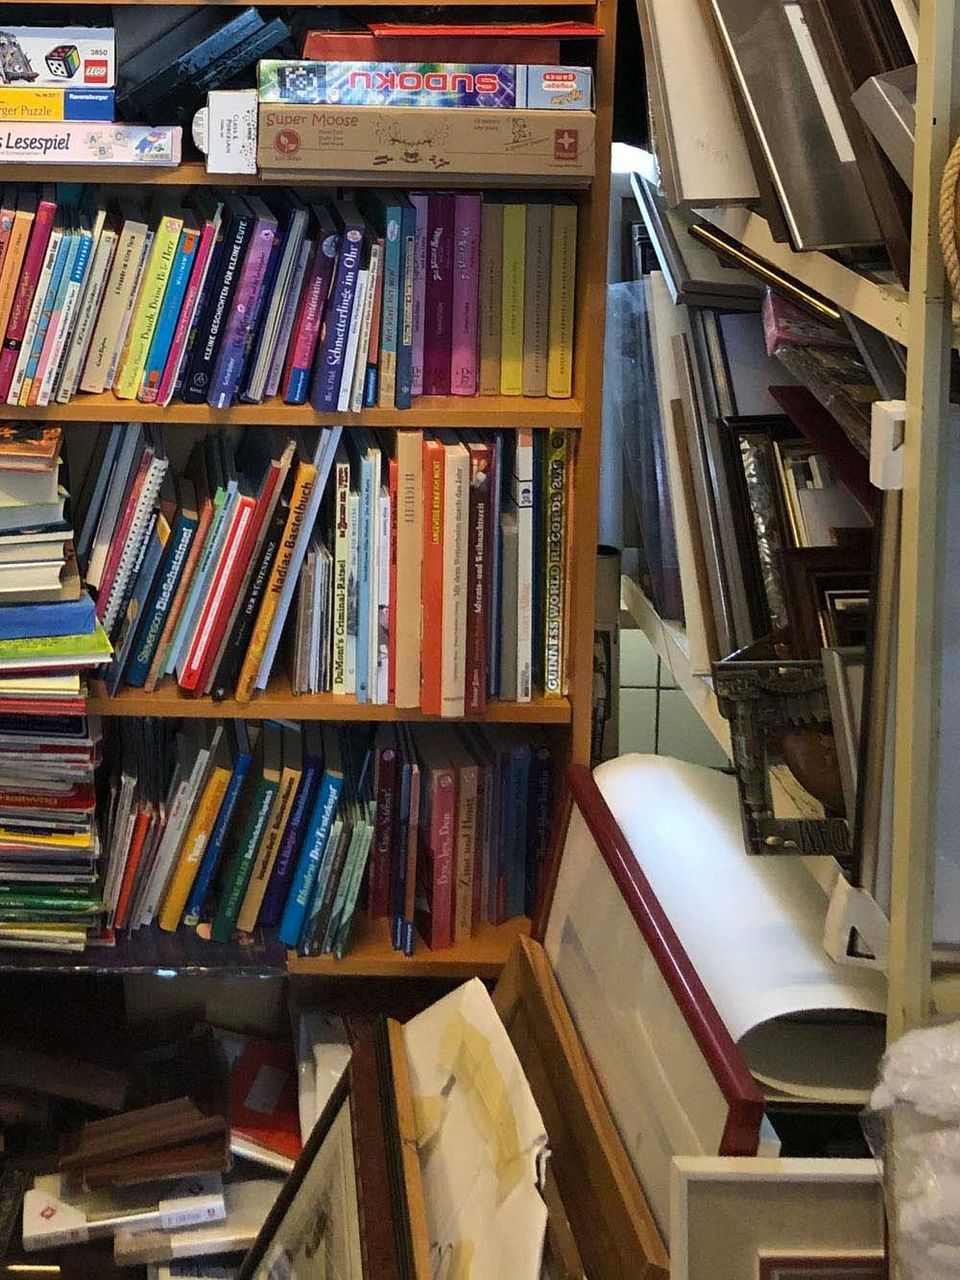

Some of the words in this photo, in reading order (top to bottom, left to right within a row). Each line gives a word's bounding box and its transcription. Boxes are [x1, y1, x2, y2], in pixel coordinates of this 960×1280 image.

[349, 71, 499, 95] SUDOKU
[21, 104, 52, 116] Puzzle
[69, 94, 109, 102] Ravensburger
[267, 114, 308, 128] Super
[312, 113, 359, 127] Moose
[6, 132, 71, 155] Lesespiel
[89, 136, 97, 145] A
[98, 146, 106, 155] B
[234, 220, 247, 243] LEUTE
[160, 239, 174, 261] Herz
[227, 244, 240, 270] KLEINE
[343, 244, 358, 268] Ohr
[223, 270, 233, 284] FÜR
[341, 270, 353, 285] im
[210, 285, 229, 334] GESCHICHTEN
[325, 287, 354, 366] Schmetterlinge
[203, 334, 216, 360] KLEINE
[280, 480, 316, 549] Bastelbuch
[549, 493, 564, 561] RECORDS
[474, 502, 486, 561] Weihnachtszeit
[161, 526, 193, 592] Schatzinsel
[247, 540, 278, 596] WÜSTENPRINZ
[268, 550, 293, 593] Nadias
[154, 589, 170, 611] Die
[335, 559, 346, 635] Criminal-Rätsel
[473, 580, 483, 614] Advents-
[548, 565, 561, 617] WORLD
[243, 596, 257, 614] DER
[135, 610, 166, 664] Stevenson
[334, 638, 344, 683] DuMont's
[545, 621, 559, 689] GUINNESS
[314, 784, 340, 838] Trotzkopf
[308, 837, 323, 859] Der
